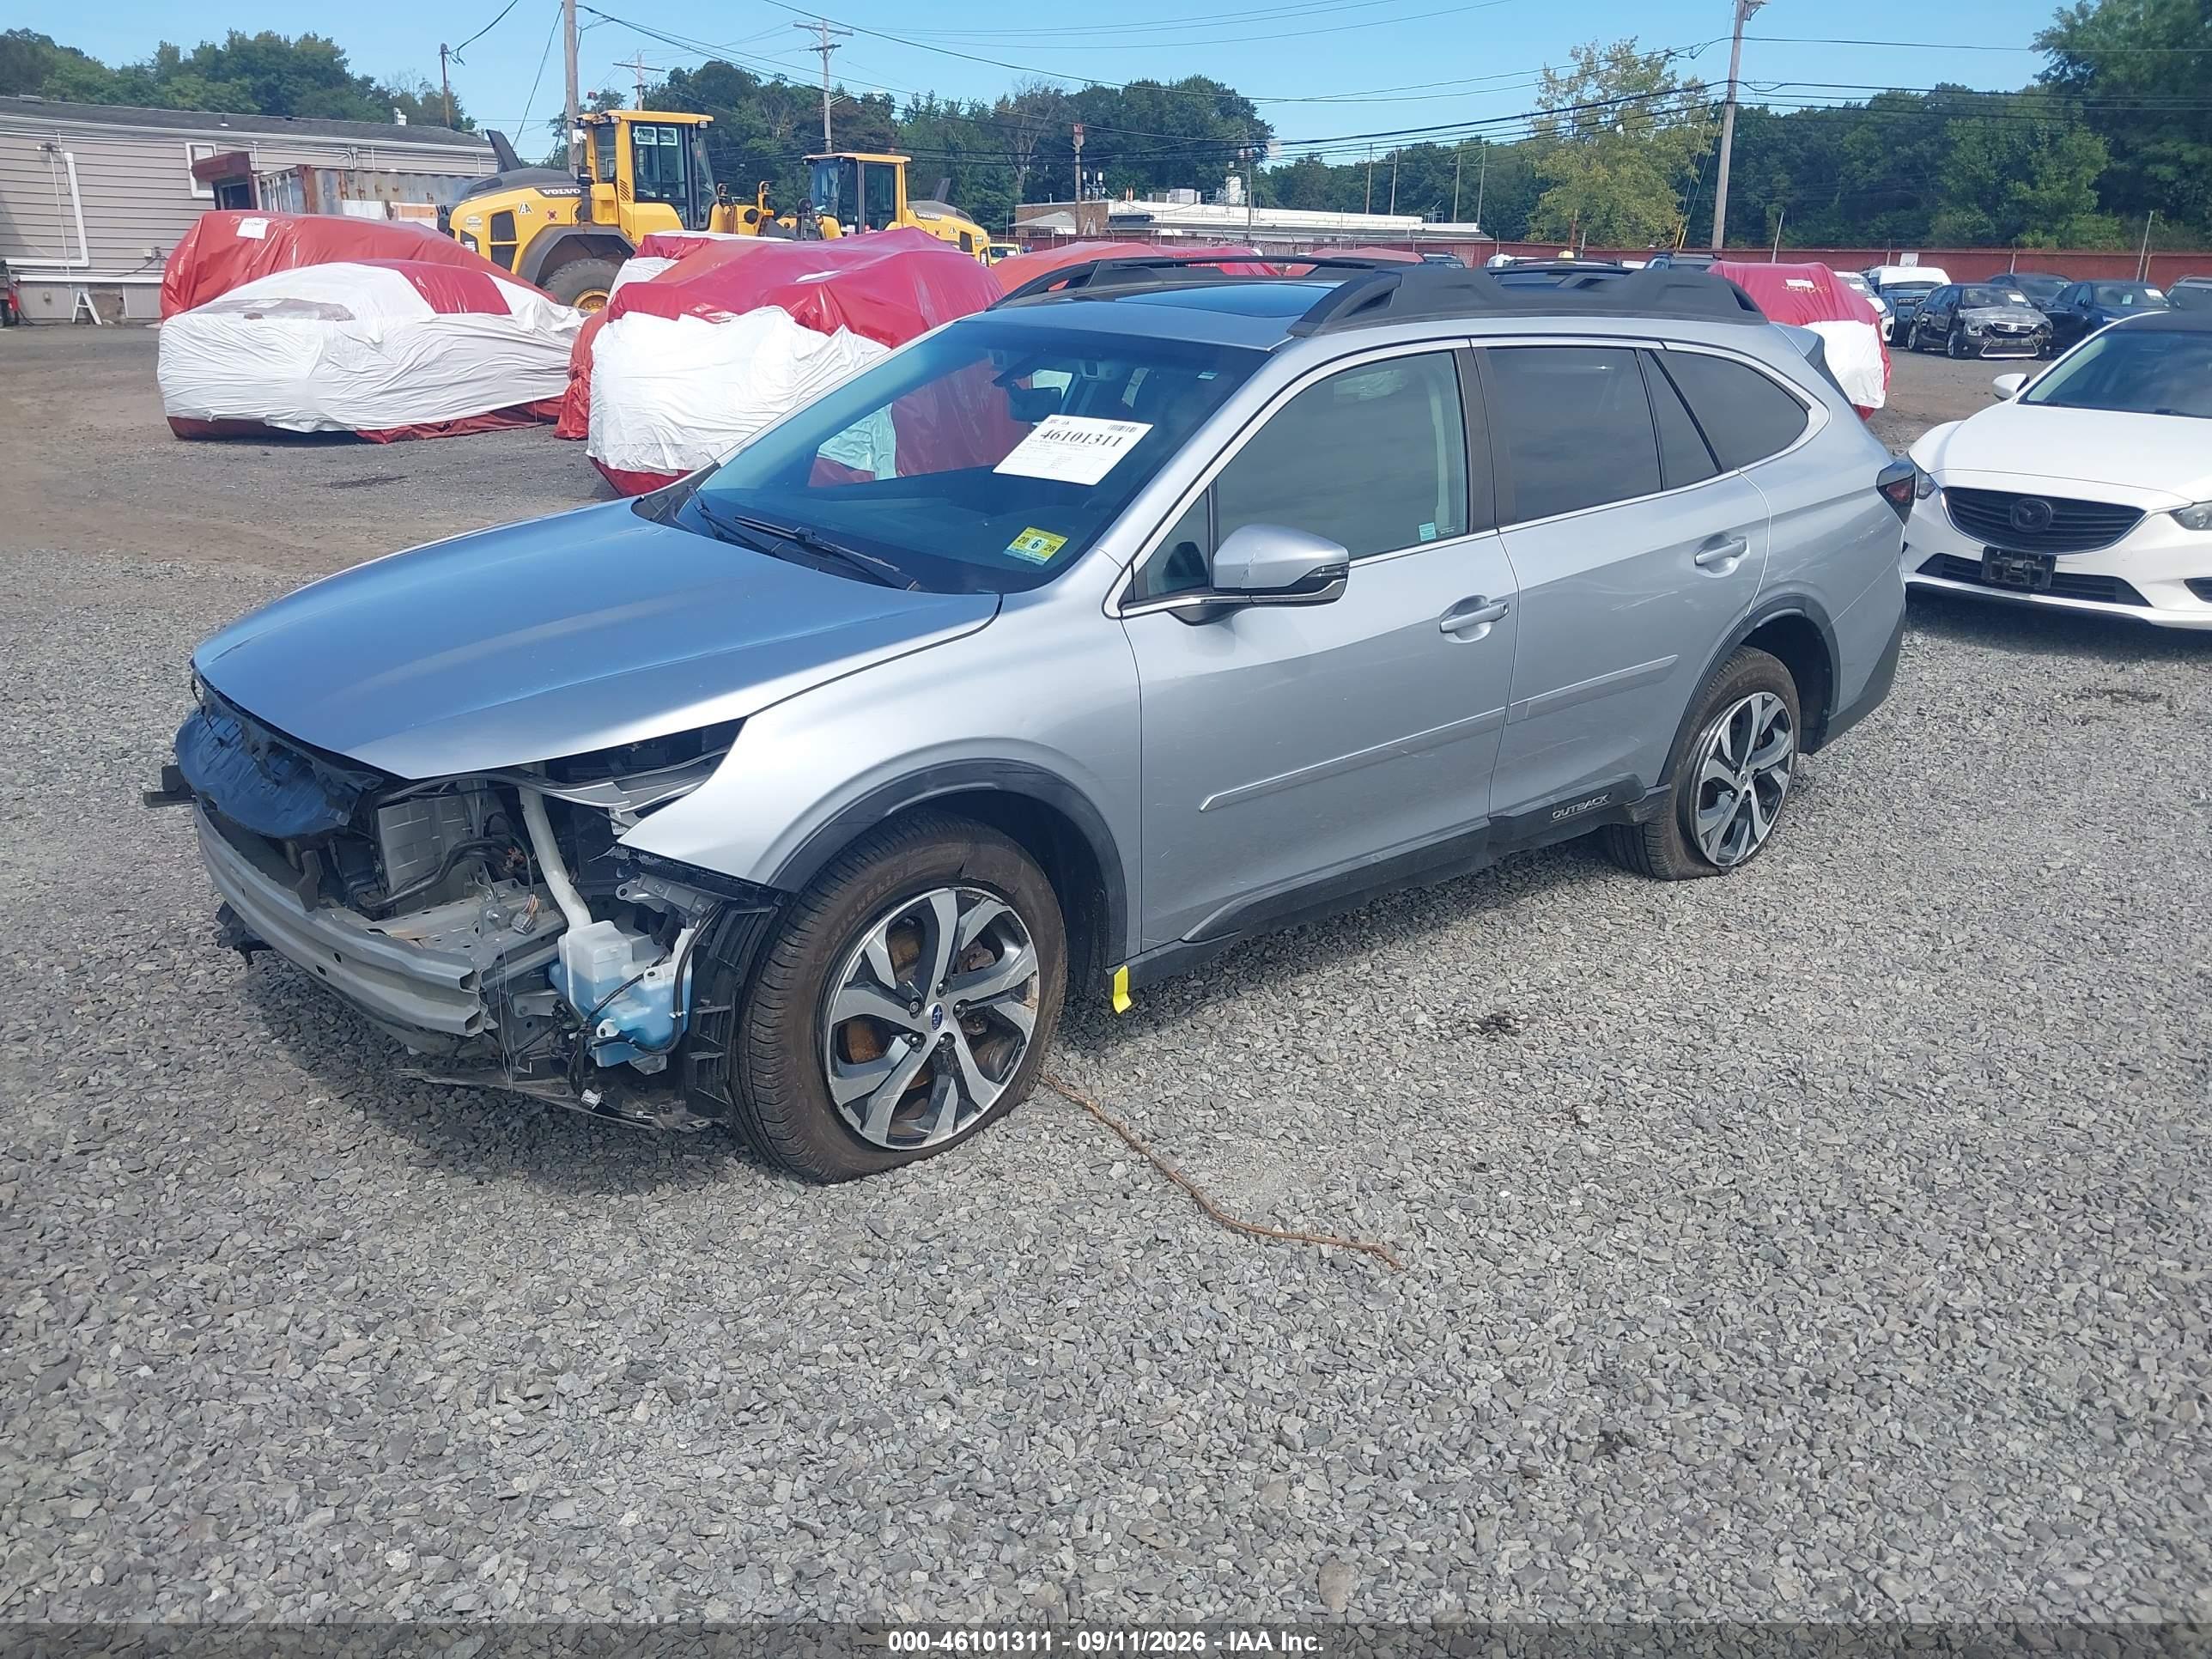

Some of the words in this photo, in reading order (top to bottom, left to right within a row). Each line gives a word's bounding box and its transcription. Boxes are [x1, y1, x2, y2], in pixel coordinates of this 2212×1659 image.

[1040, 428, 1124, 447] 46101311
[1018, 536, 1030, 544] 20
[1030, 538, 1042, 550] 6
[1552, 793, 1610, 819] OUTBACK
